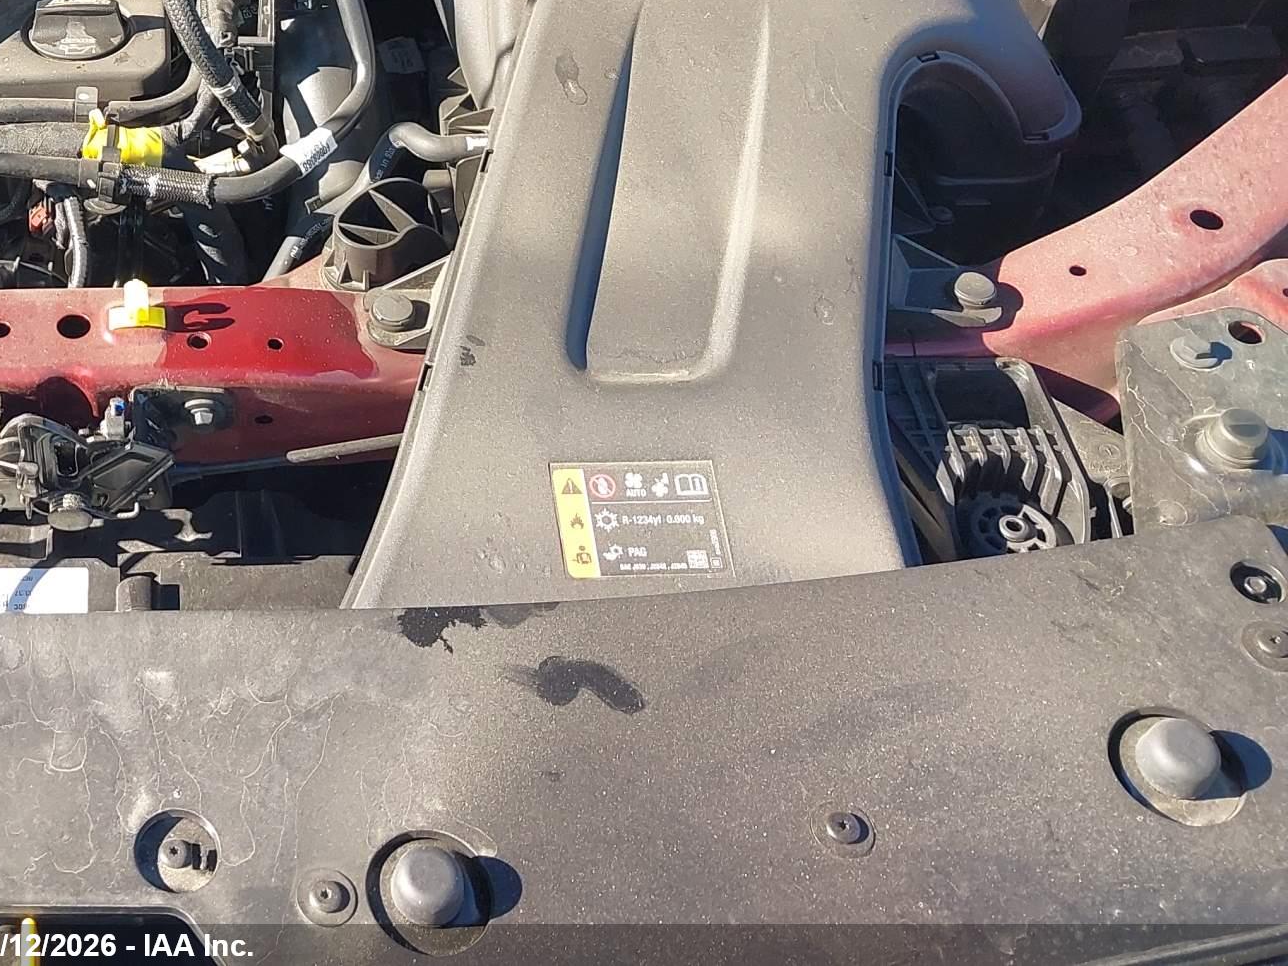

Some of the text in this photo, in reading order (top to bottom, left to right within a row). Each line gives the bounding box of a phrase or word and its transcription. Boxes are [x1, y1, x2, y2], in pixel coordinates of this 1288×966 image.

[625, 488, 647, 498] AUTO
[622, 514, 662, 526] R-1234yf
[692, 513, 705, 525] kg
[627, 546, 648, 557] PAG
